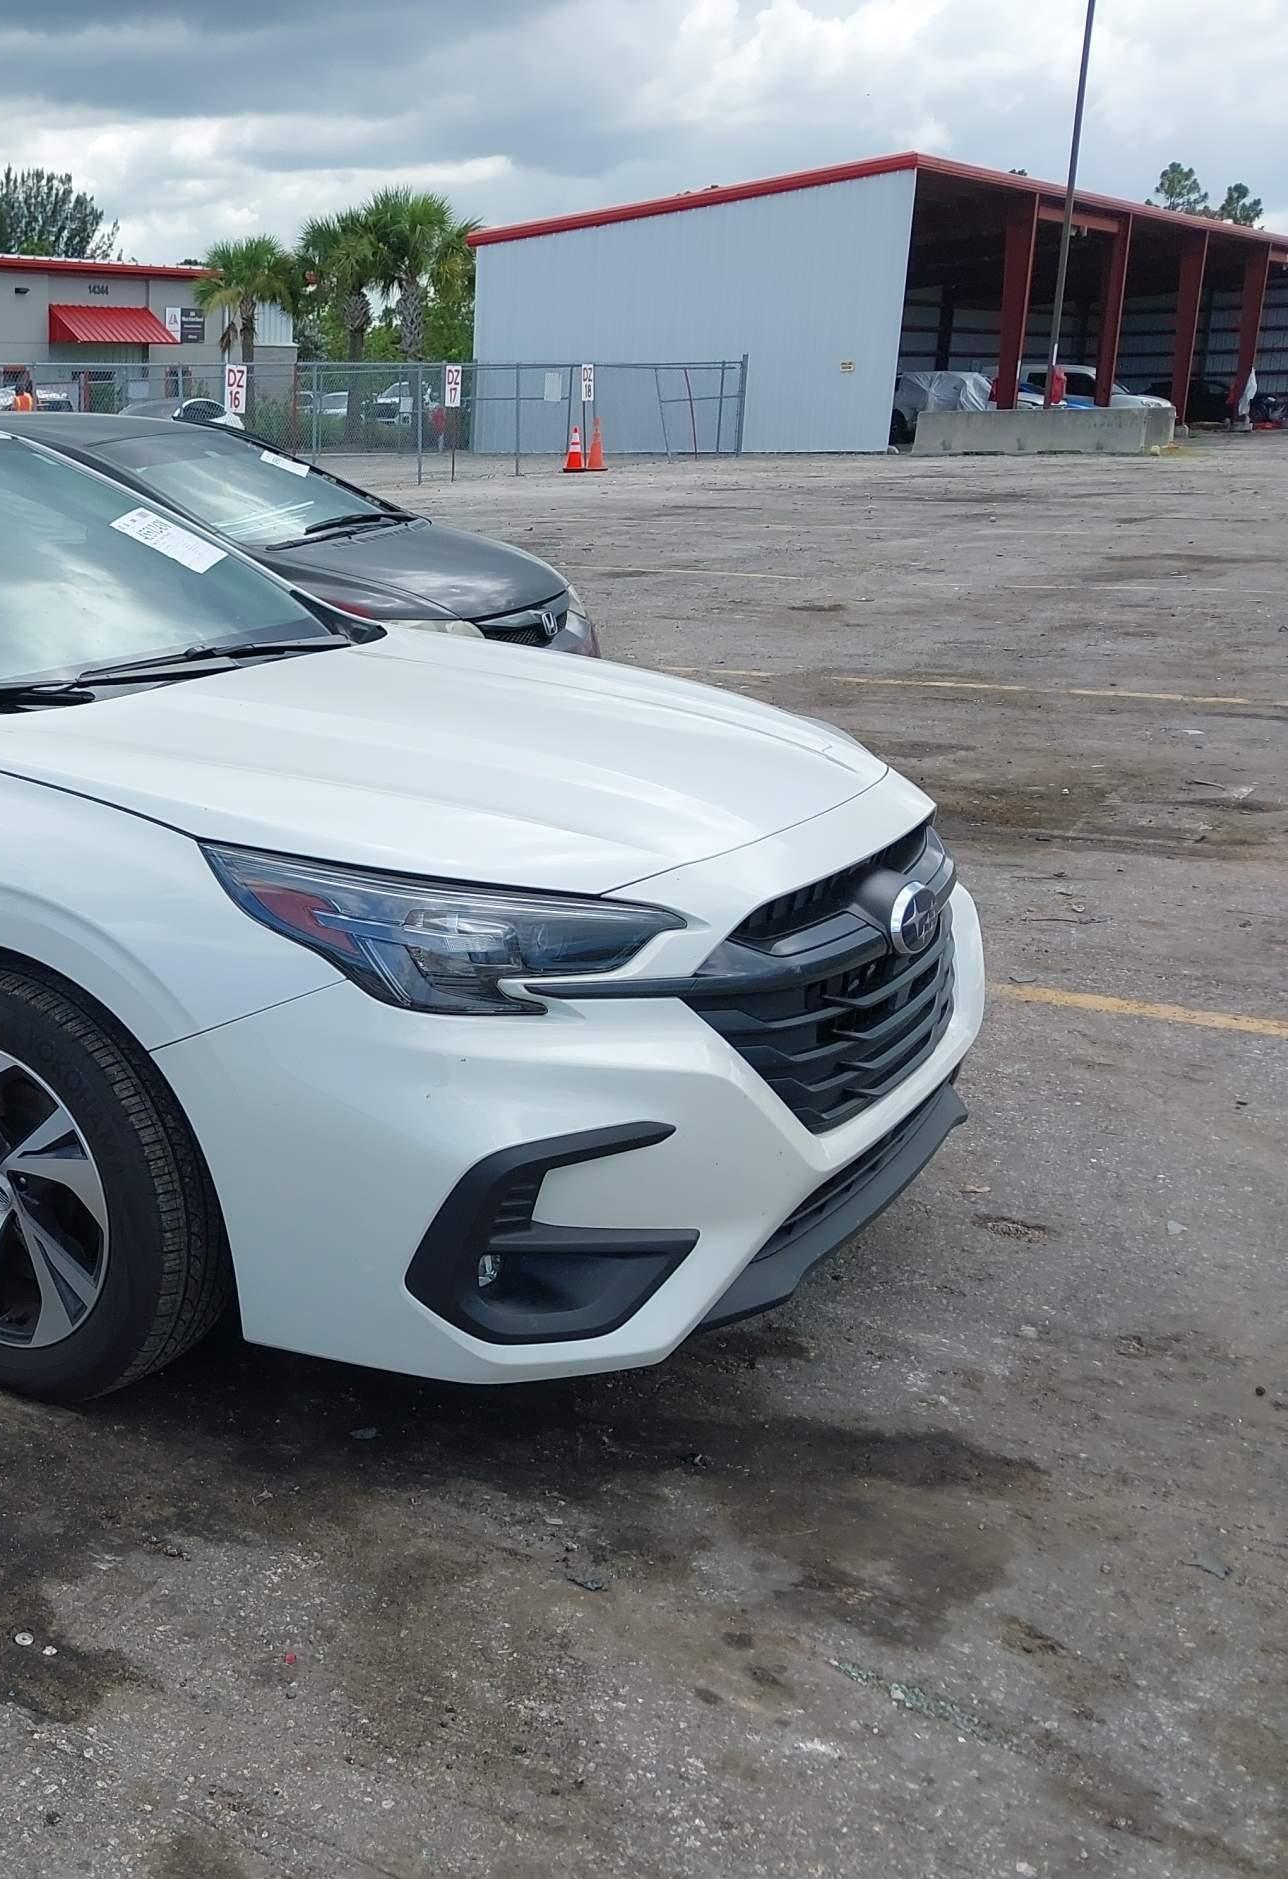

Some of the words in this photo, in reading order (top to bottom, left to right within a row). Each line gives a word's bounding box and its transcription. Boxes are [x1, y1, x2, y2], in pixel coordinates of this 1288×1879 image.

[227, 368, 244, 388] DZ
[447, 369, 460, 385] DZ
[582, 367, 593, 382] DZ
[449, 387, 457, 404] 17
[584, 383, 591, 398] 18
[229, 391, 240, 409] 16
